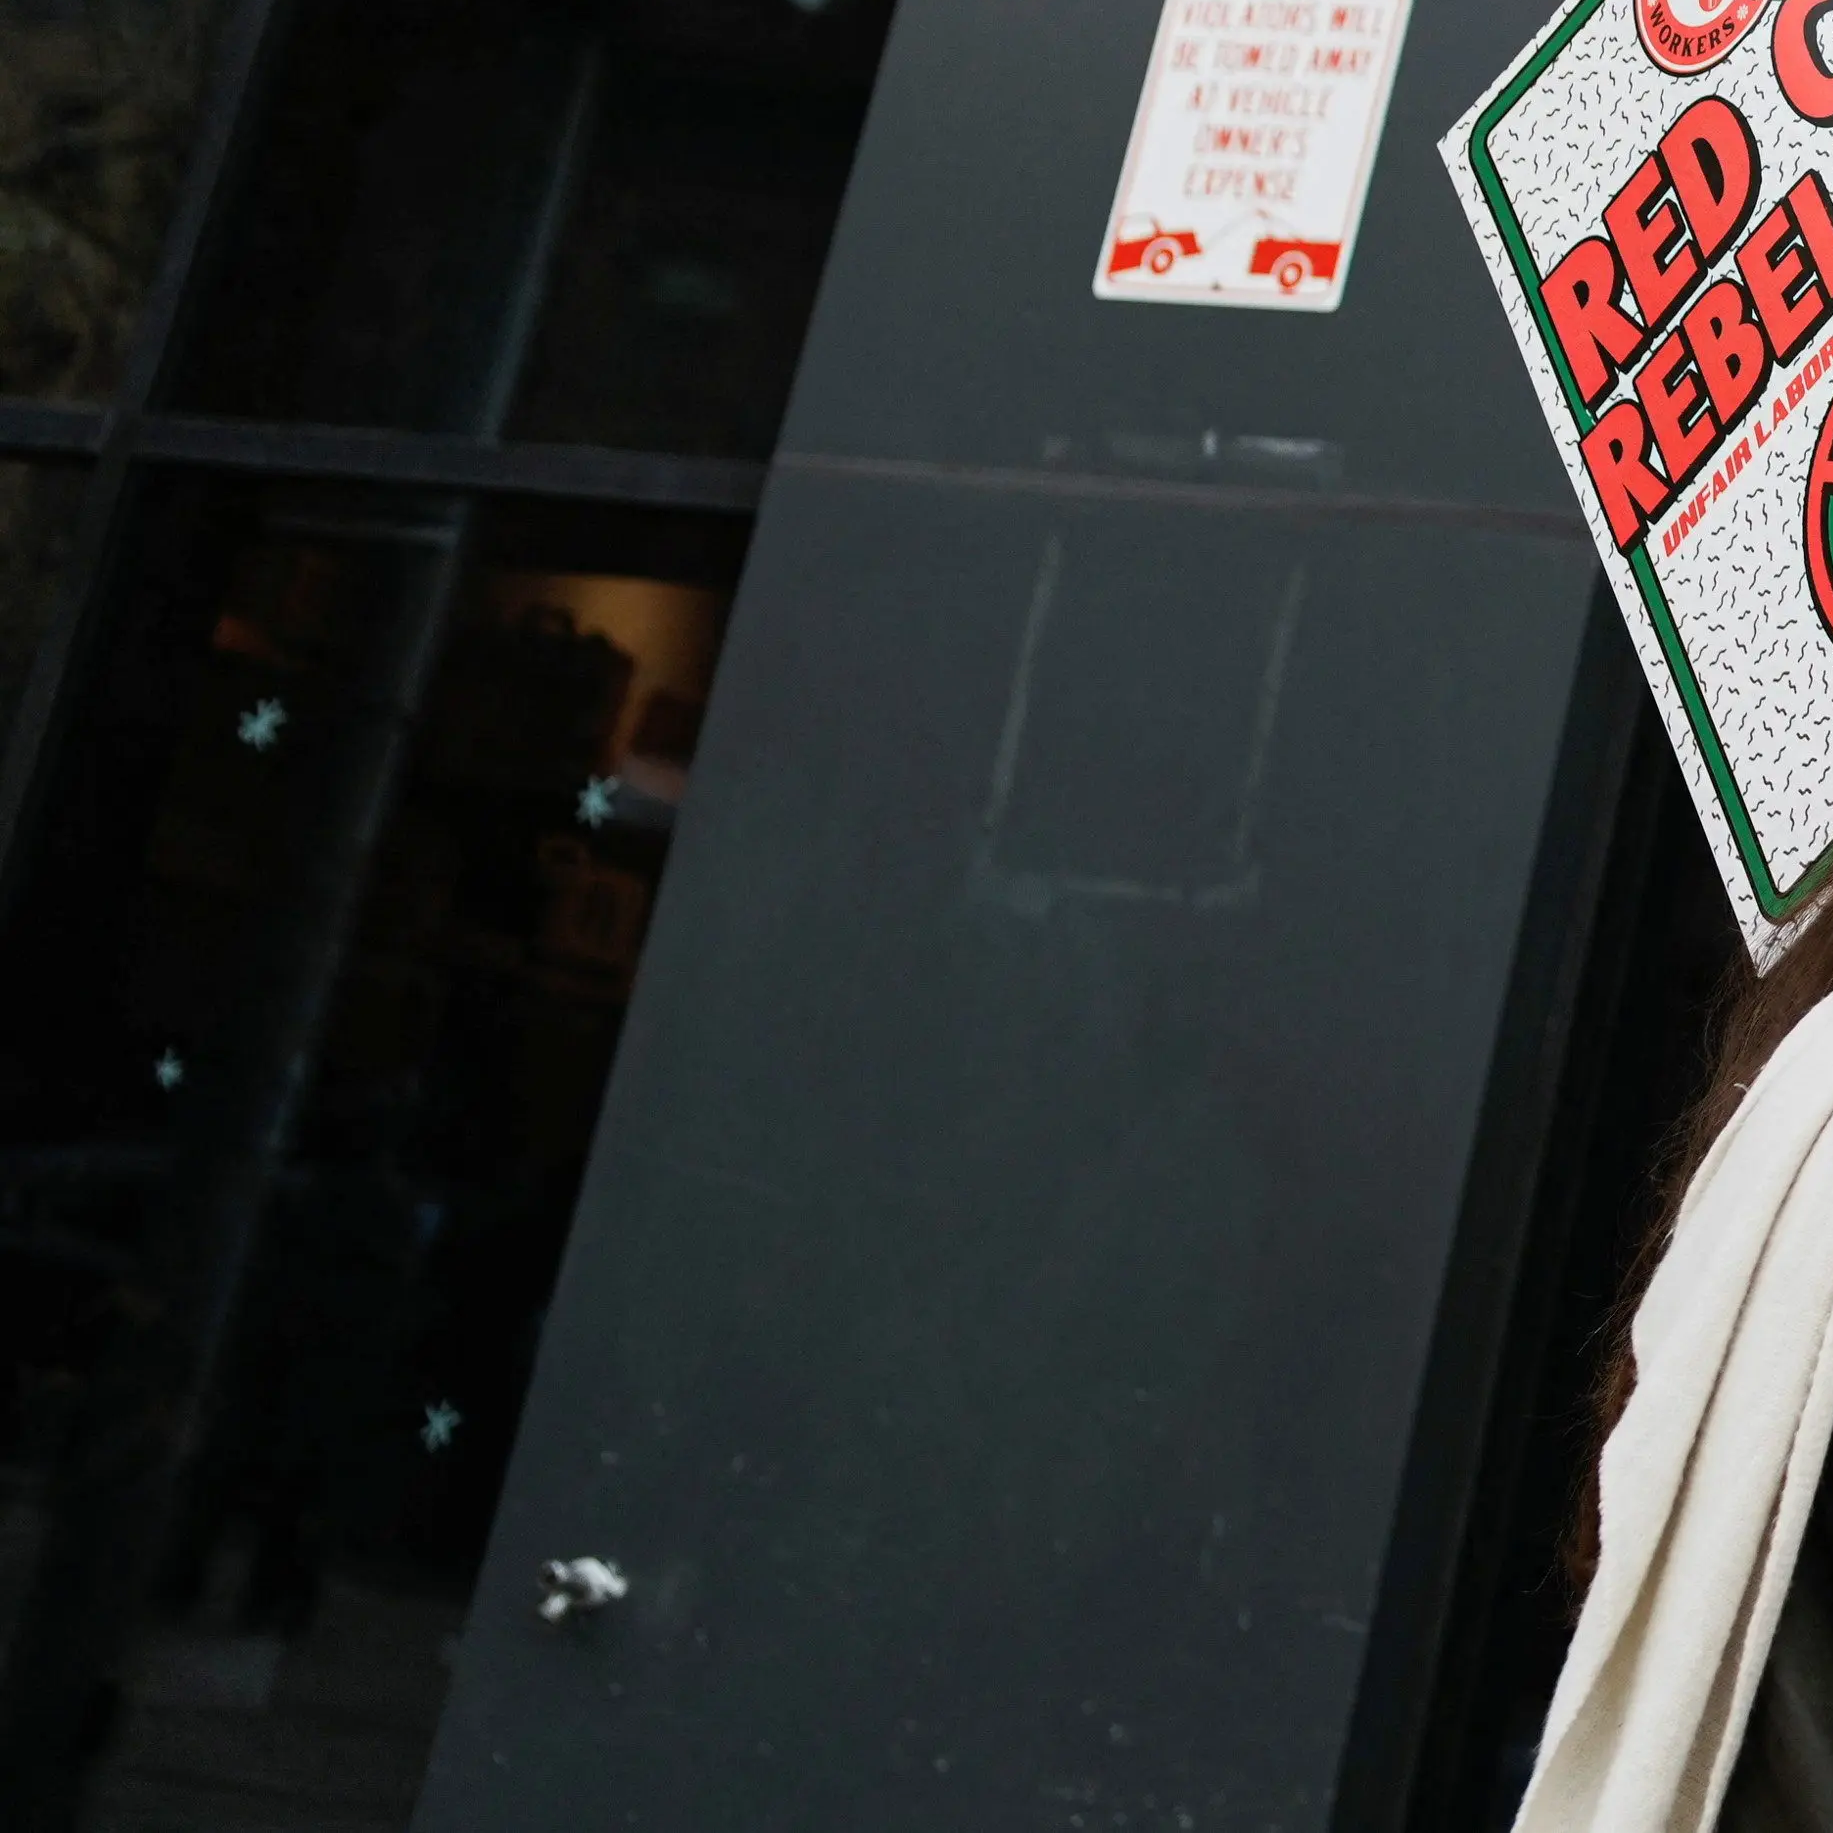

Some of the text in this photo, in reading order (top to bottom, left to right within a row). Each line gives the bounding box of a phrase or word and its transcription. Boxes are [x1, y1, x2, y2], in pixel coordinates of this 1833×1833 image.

[1650, 3, 1736, 58] WORKERS
[1539, 95, 1761, 410] RED
[1662, 436, 1752, 557] UNFAIR
